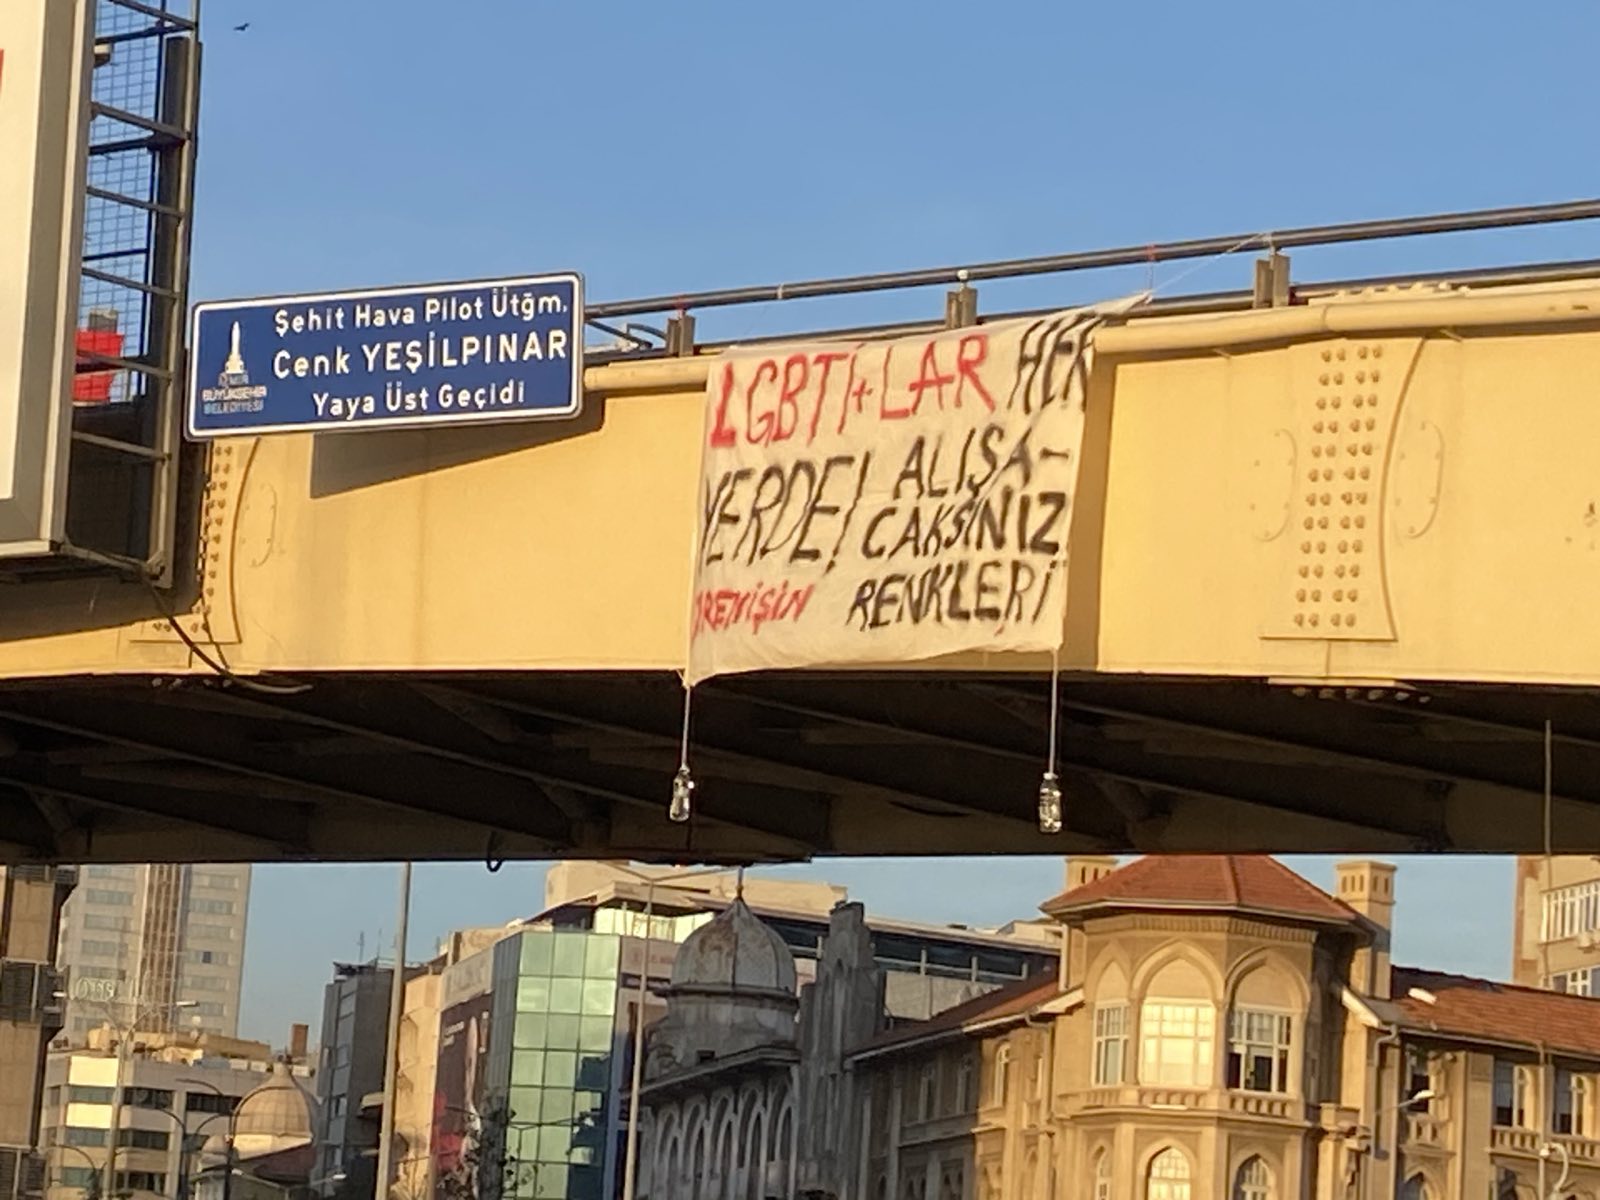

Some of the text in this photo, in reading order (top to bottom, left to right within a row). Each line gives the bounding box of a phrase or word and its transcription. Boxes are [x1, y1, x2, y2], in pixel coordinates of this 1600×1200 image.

[275, 308, 345, 338] Şehit
[354, 303, 415, 328] Hava
[425, 298, 484, 323] Pilot
[273, 329, 567, 379] Cenk YEŞİLPINAR
[312, 379, 525, 420] Yaya Üst Geçidi
[845, 559, 1055, 631] RENKLERİ
